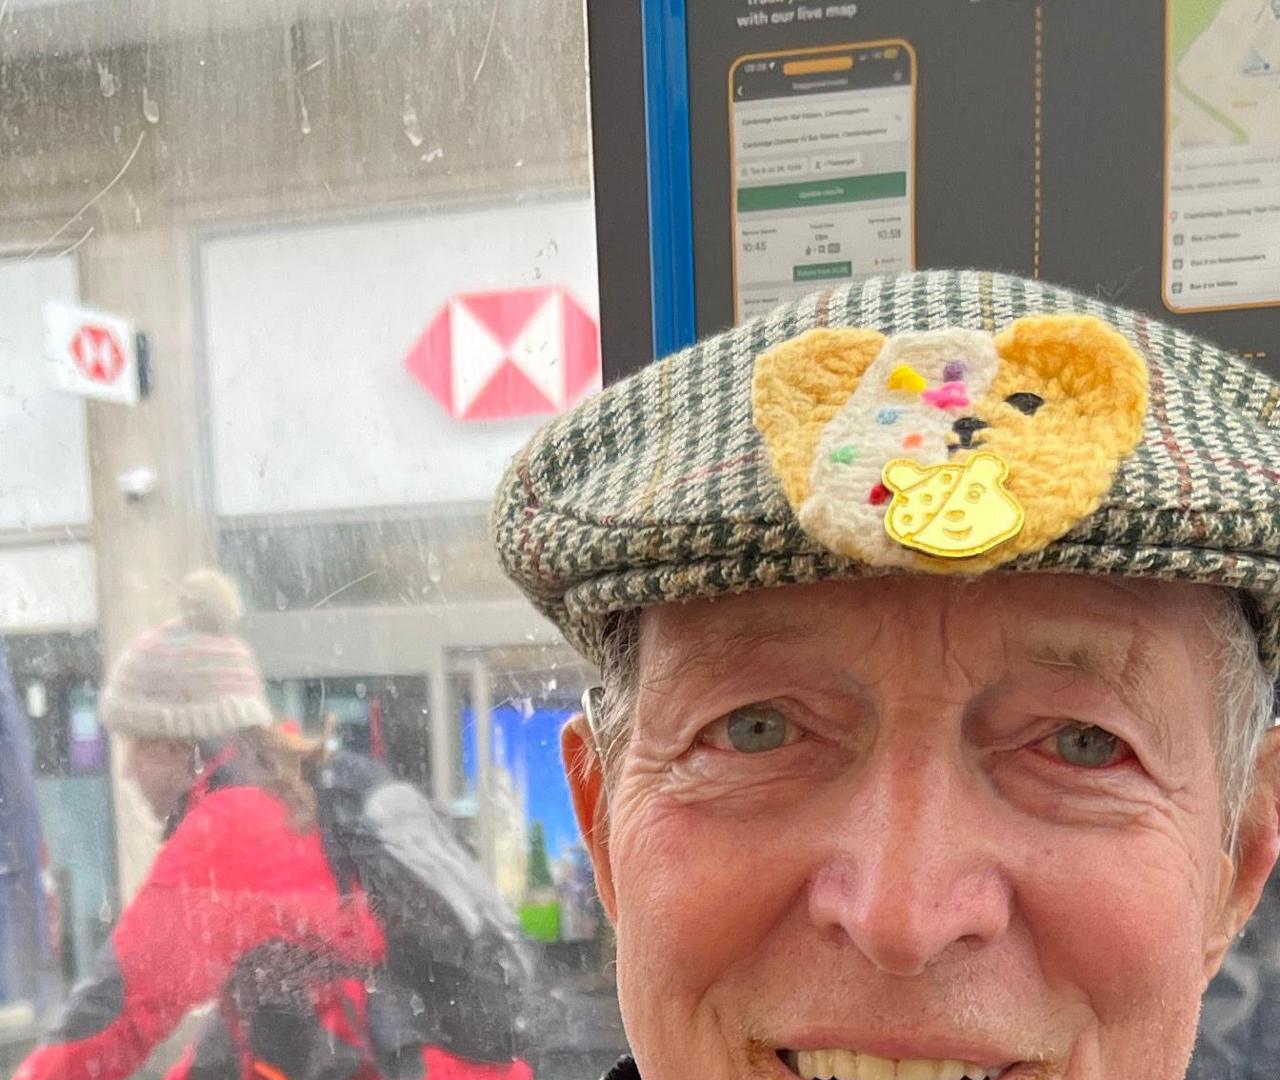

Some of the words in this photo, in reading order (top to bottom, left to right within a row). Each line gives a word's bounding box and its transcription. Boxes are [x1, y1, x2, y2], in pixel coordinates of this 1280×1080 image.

[736, 11, 768, 28] with
[771, 11, 795, 24] our
[797, 6, 823, 20] live
[825, 4, 858, 18] map
